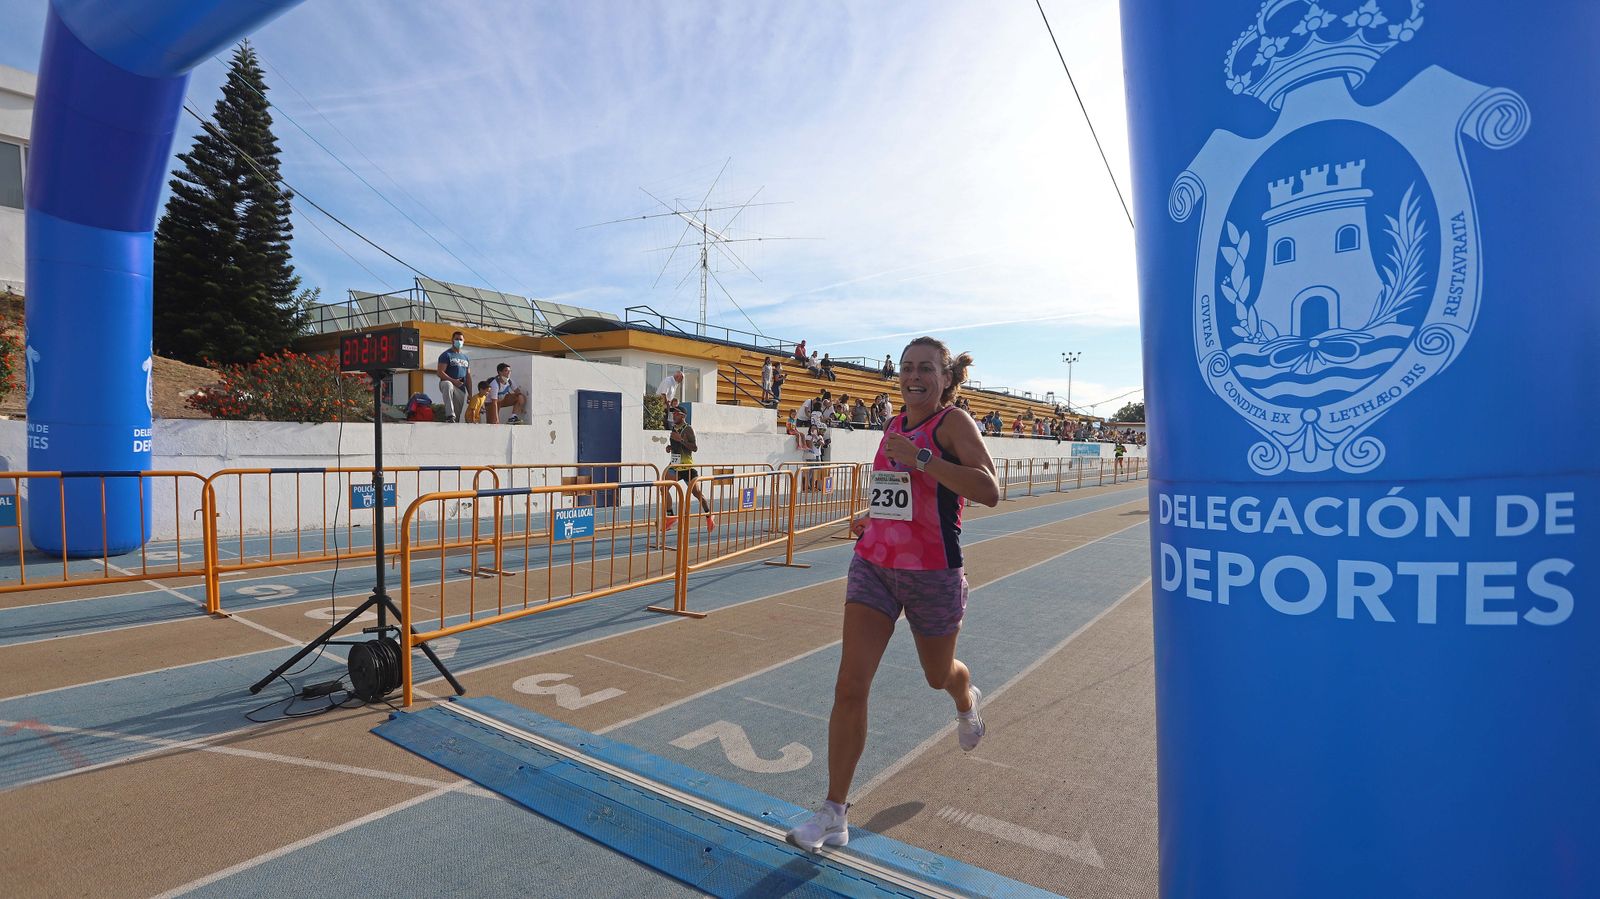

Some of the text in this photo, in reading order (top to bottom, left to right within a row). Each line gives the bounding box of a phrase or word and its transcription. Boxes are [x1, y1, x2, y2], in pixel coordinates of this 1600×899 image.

[1443, 210, 1467, 317] RESTAVRATA
[1200, 294, 1214, 347] CIVITAS
[1400, 363, 1426, 388] BIS
[1224, 381, 1291, 423] CONDITA EX
[36, 424, 49, 434] DE
[556, 507, 593, 520] POLICÍA LOCAL
[870, 488, 909, 508] 230
[1159, 486, 1575, 538] DELEGACIÓN DE
[1161, 542, 1575, 626] DEPORTES
[512, 672, 627, 710] 3
[668, 720, 813, 773] 2
